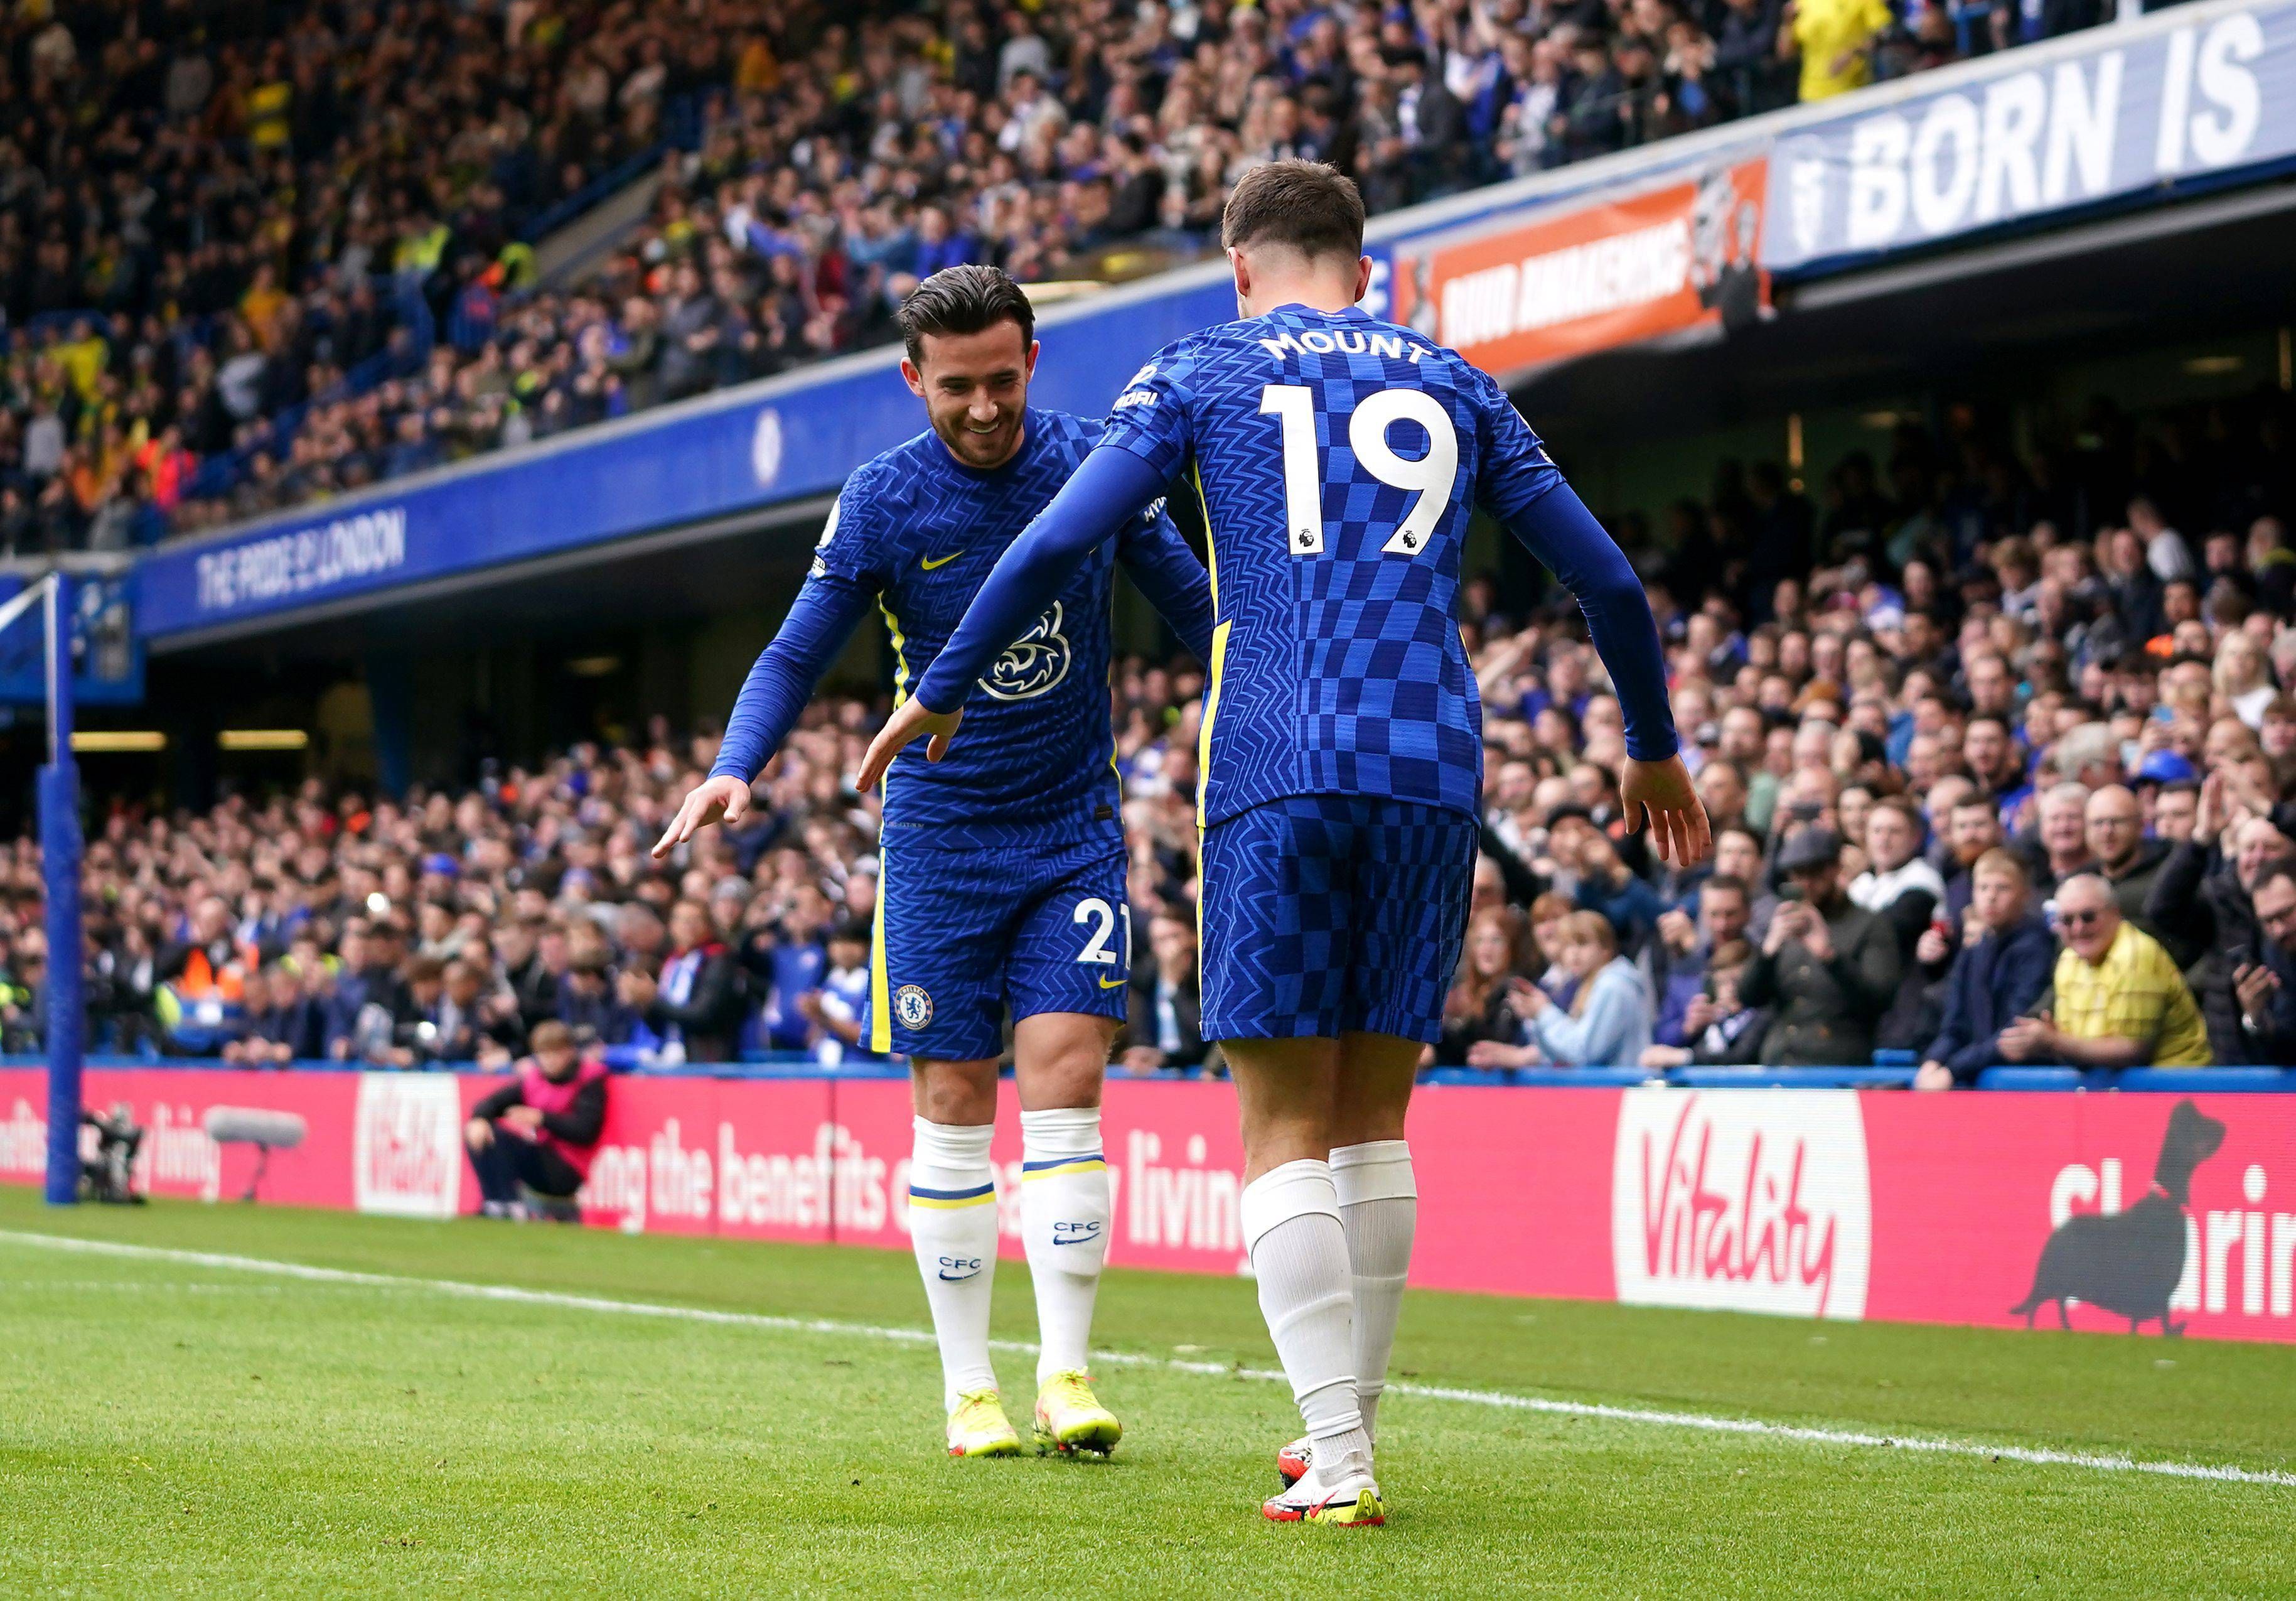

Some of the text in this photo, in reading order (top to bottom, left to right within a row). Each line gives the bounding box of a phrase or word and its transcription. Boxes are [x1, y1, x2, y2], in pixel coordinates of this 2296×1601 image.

[1847, 12, 2265, 249] BORN IS
[1258, 330, 1433, 364] MOUNT
[1258, 384, 1459, 557] 19
[196, 553, 237, 608] THE
[315, 505, 407, 584] LONDON
[1073, 897, 1132, 971] 21
[650, 1117, 713, 1219] the
[717, 1121, 886, 1231] benefits
[1054, 1221, 1100, 1233] CFC
[1129, 1129, 1254, 1276] livin
[1641, 1092, 1837, 1317] Vitality
[939, 1256, 982, 1269] CFC
